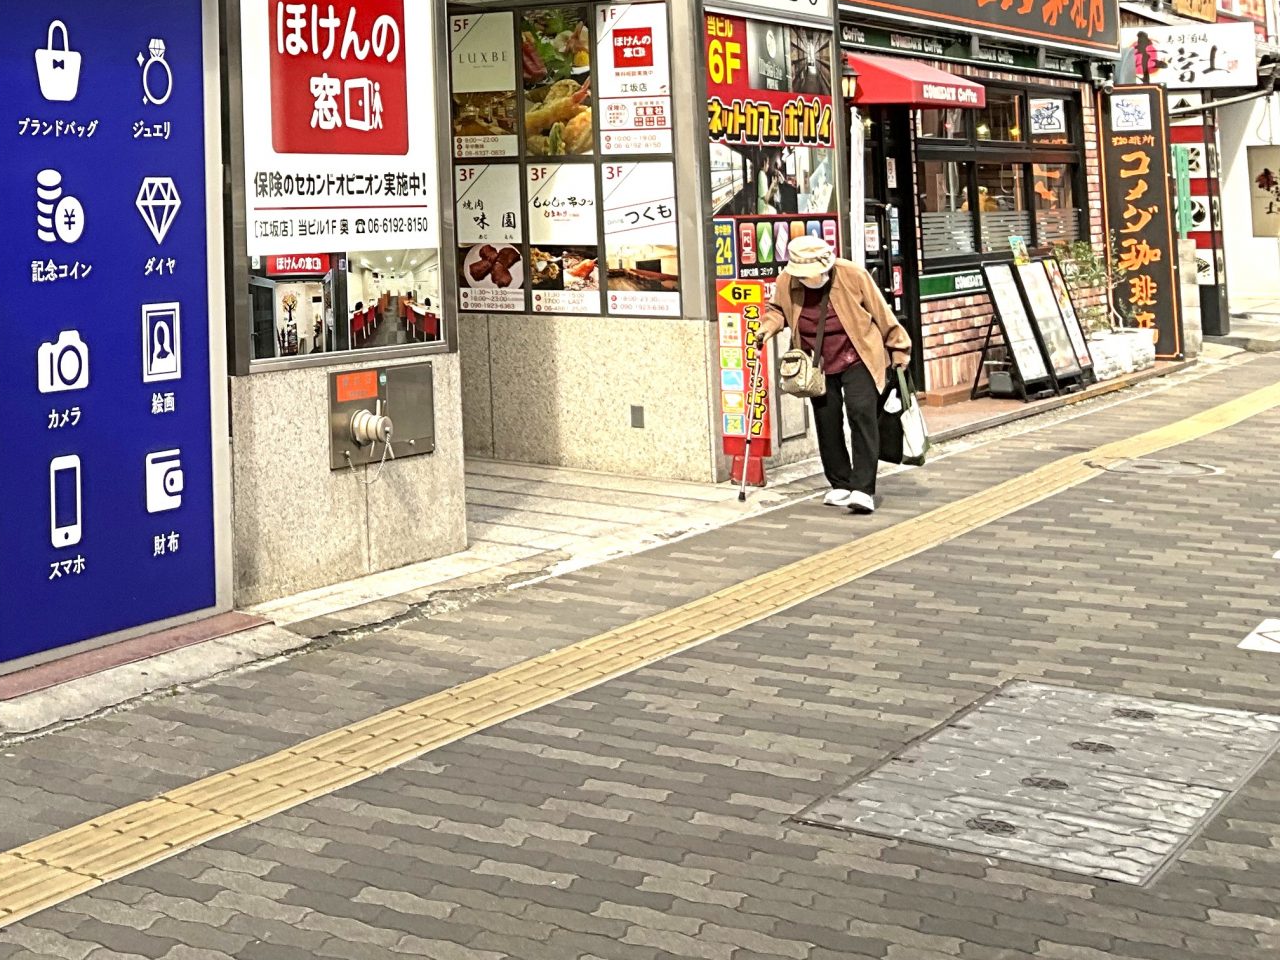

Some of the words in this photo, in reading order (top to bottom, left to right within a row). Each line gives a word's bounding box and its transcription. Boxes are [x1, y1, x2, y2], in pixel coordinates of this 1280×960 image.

[600, 8, 616, 22] 1F
[277, 0, 400, 63] ほけんの
[453, 19, 469, 32] 5F
[707, 16, 733, 38] 当ビル
[614, 35, 651, 47] ほけんの
[842, 26, 865, 43] Coffee
[923, 37, 943, 55] Coffee
[459, 51, 508, 64] LUXBE
[708, 39, 741, 85] 6F
[620, 83, 648, 93] 江坂店
[957, 87, 977, 104] Coffee
[310, 73, 372, 131] 窓口
[18, 117, 99, 139] ブランドバッグ
[132, 120, 171, 140] ジュエリ
[707, 97, 781, 141] ネットカフェ
[783, 96, 832, 145] ポパイ
[459, 168, 475, 182] 3F
[530, 167, 547, 182] 3F
[606, 166, 623, 180] 3F
[462, 199, 484, 211] 焼肉
[624, 204, 673, 225] つくも
[368, 217, 428, 234] 06-6192-8150
[716, 237, 732, 263] 24
[30, 259, 93, 283] 記念コイン
[143, 255, 176, 277] ダイヤ
[732, 287, 752, 301] 6F
[47, 405, 82, 429] カメラ
[150, 392, 176, 415] 絵画
[48, 555, 86, 580] スマホ
[153, 532, 180, 556] 財布
